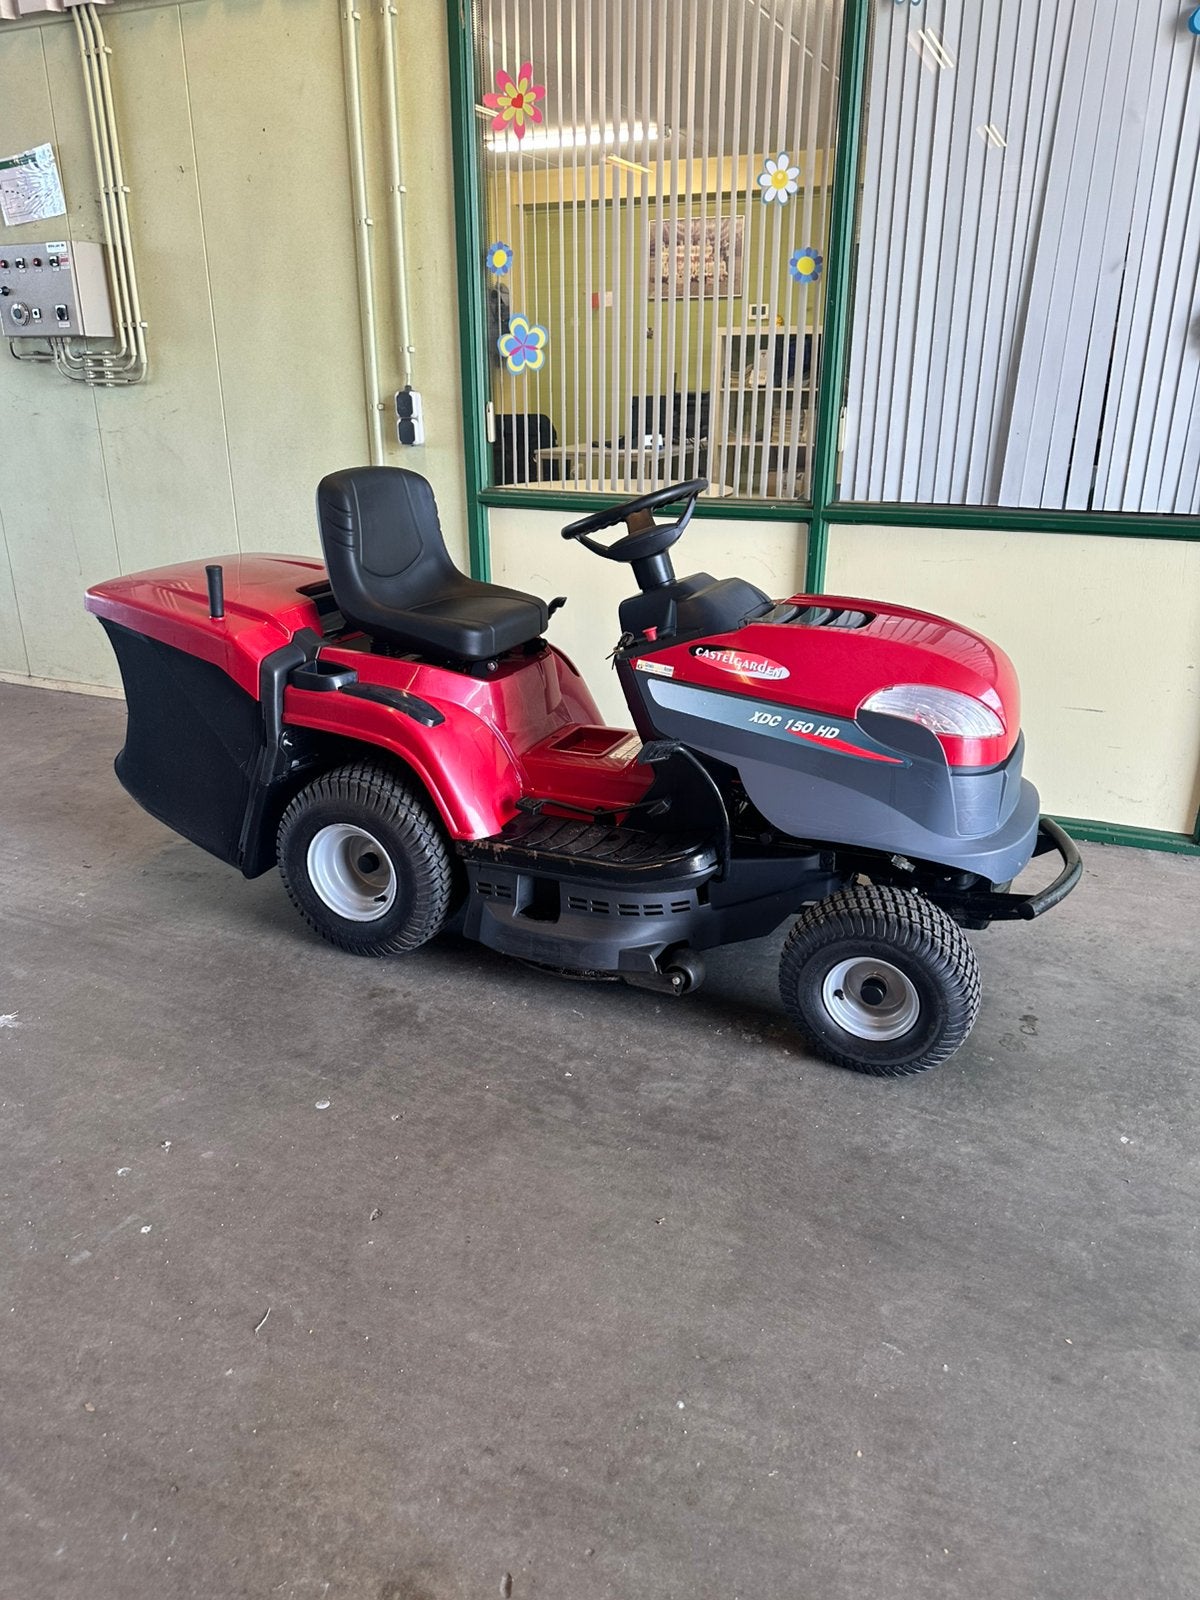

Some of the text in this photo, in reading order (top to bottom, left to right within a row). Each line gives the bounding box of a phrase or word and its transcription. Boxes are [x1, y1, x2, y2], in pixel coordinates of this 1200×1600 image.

[748, 711, 840, 739] XDC 150 HD
